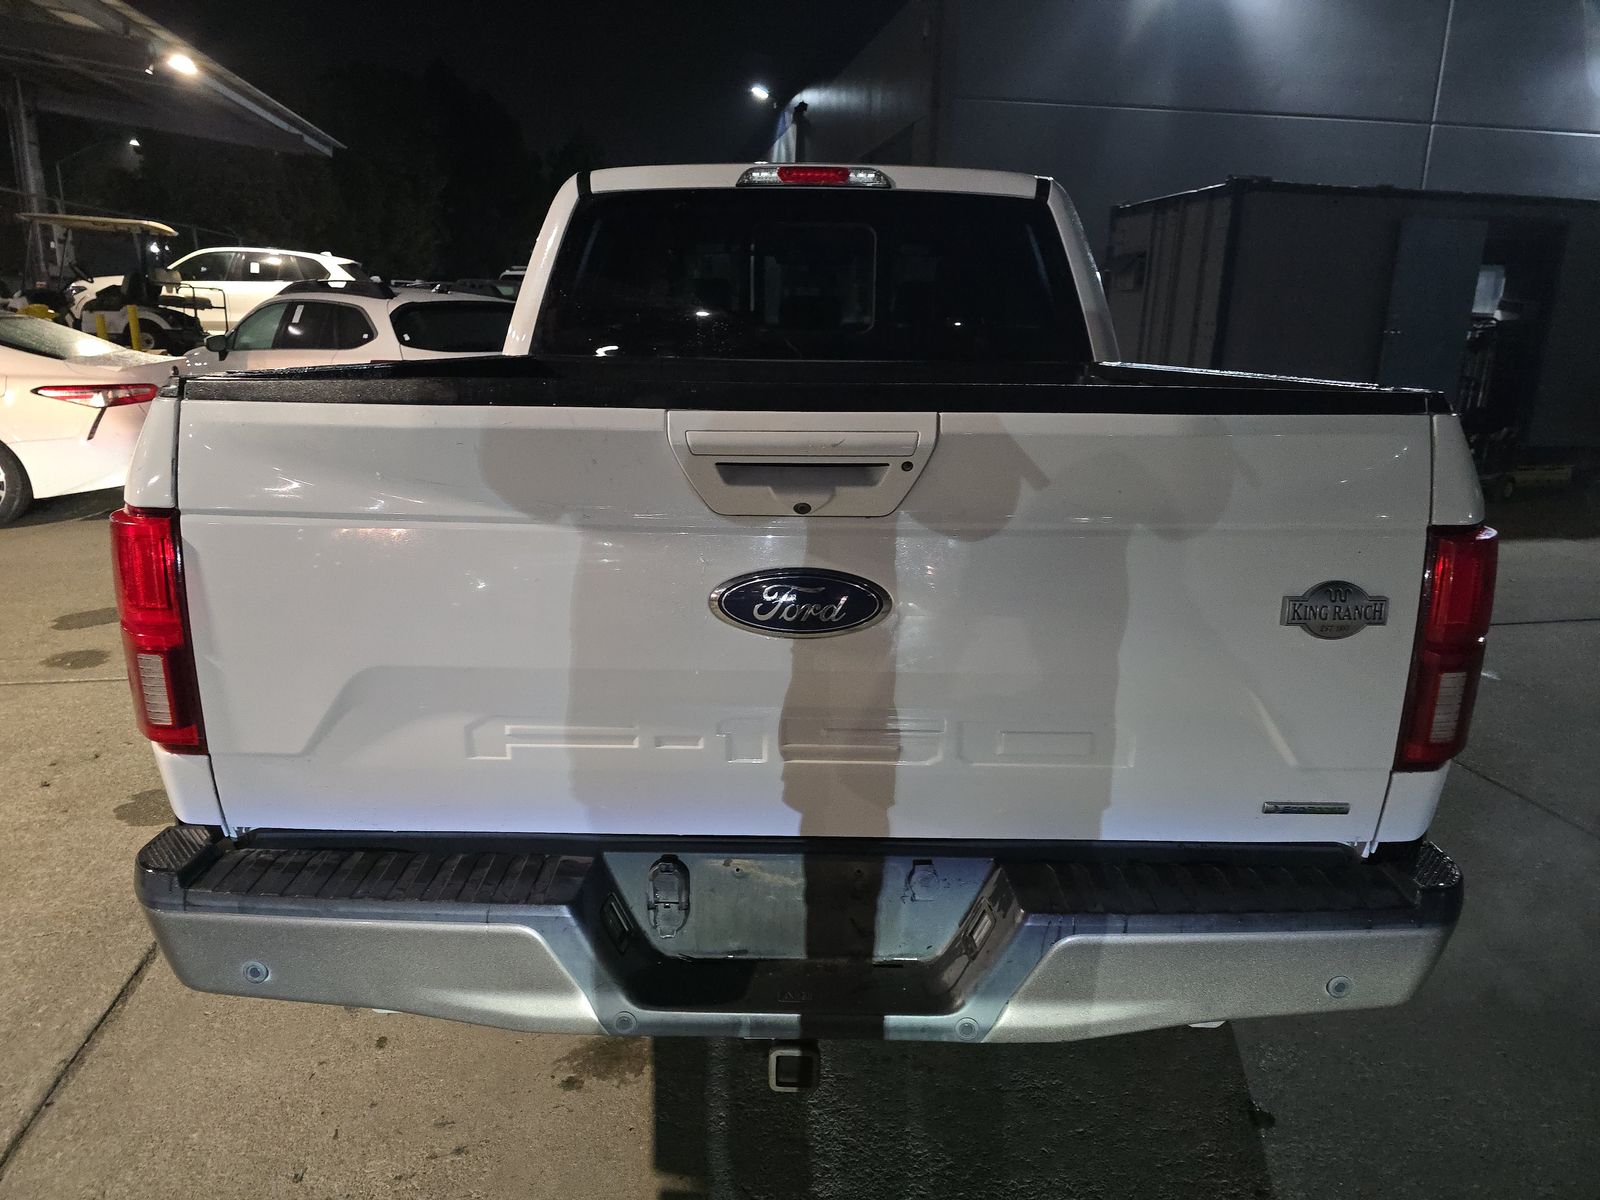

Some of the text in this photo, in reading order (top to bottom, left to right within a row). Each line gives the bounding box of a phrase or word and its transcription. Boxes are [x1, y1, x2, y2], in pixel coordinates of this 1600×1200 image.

[752, 584, 849, 622] Ford
[1291, 602, 1385, 621] KING RANCH
[464, 716, 1136, 768] F-150
